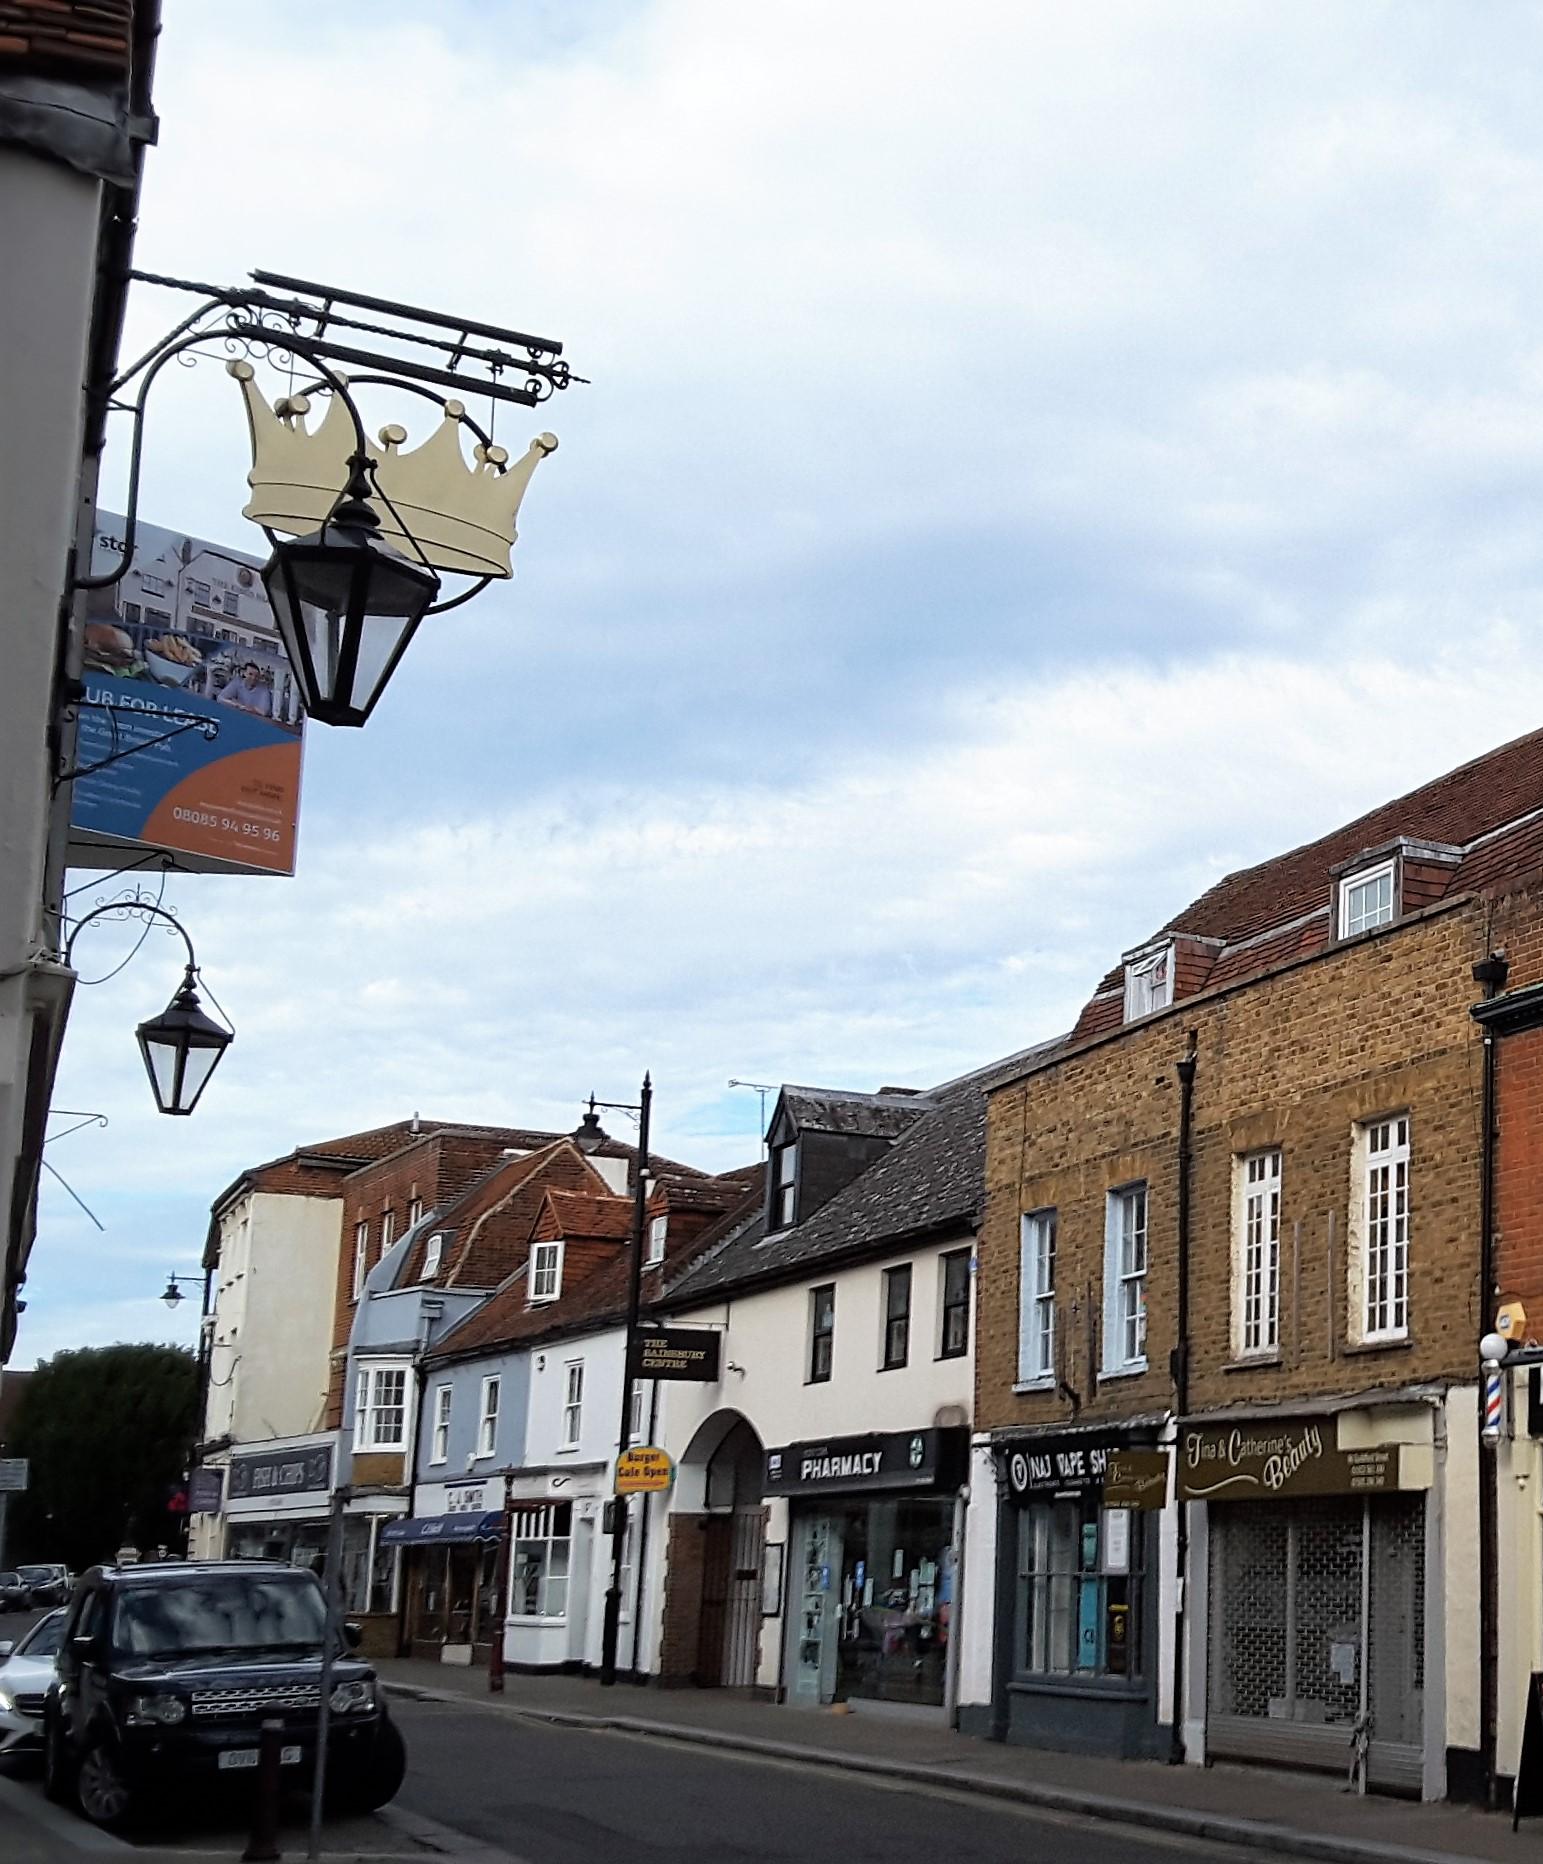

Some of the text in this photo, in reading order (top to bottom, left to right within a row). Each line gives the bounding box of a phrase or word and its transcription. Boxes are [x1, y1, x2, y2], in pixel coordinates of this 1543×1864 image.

[173, 806, 218, 828] 08085
[221, 818, 240, 834] 94
[242, 822, 260, 838] 95
[263, 827, 281, 843] 96
[643, 1338, 669, 1348] THE
[627, 1451, 661, 1464] Burger
[1056, 1450, 1086, 1478] VAPE
[1186, 1432, 1217, 1469] Tina
[1217, 1440, 1226, 1459] &
[1262, 1424, 1323, 1491] Beauty
[801, 1451, 883, 1481] PHARMACY
